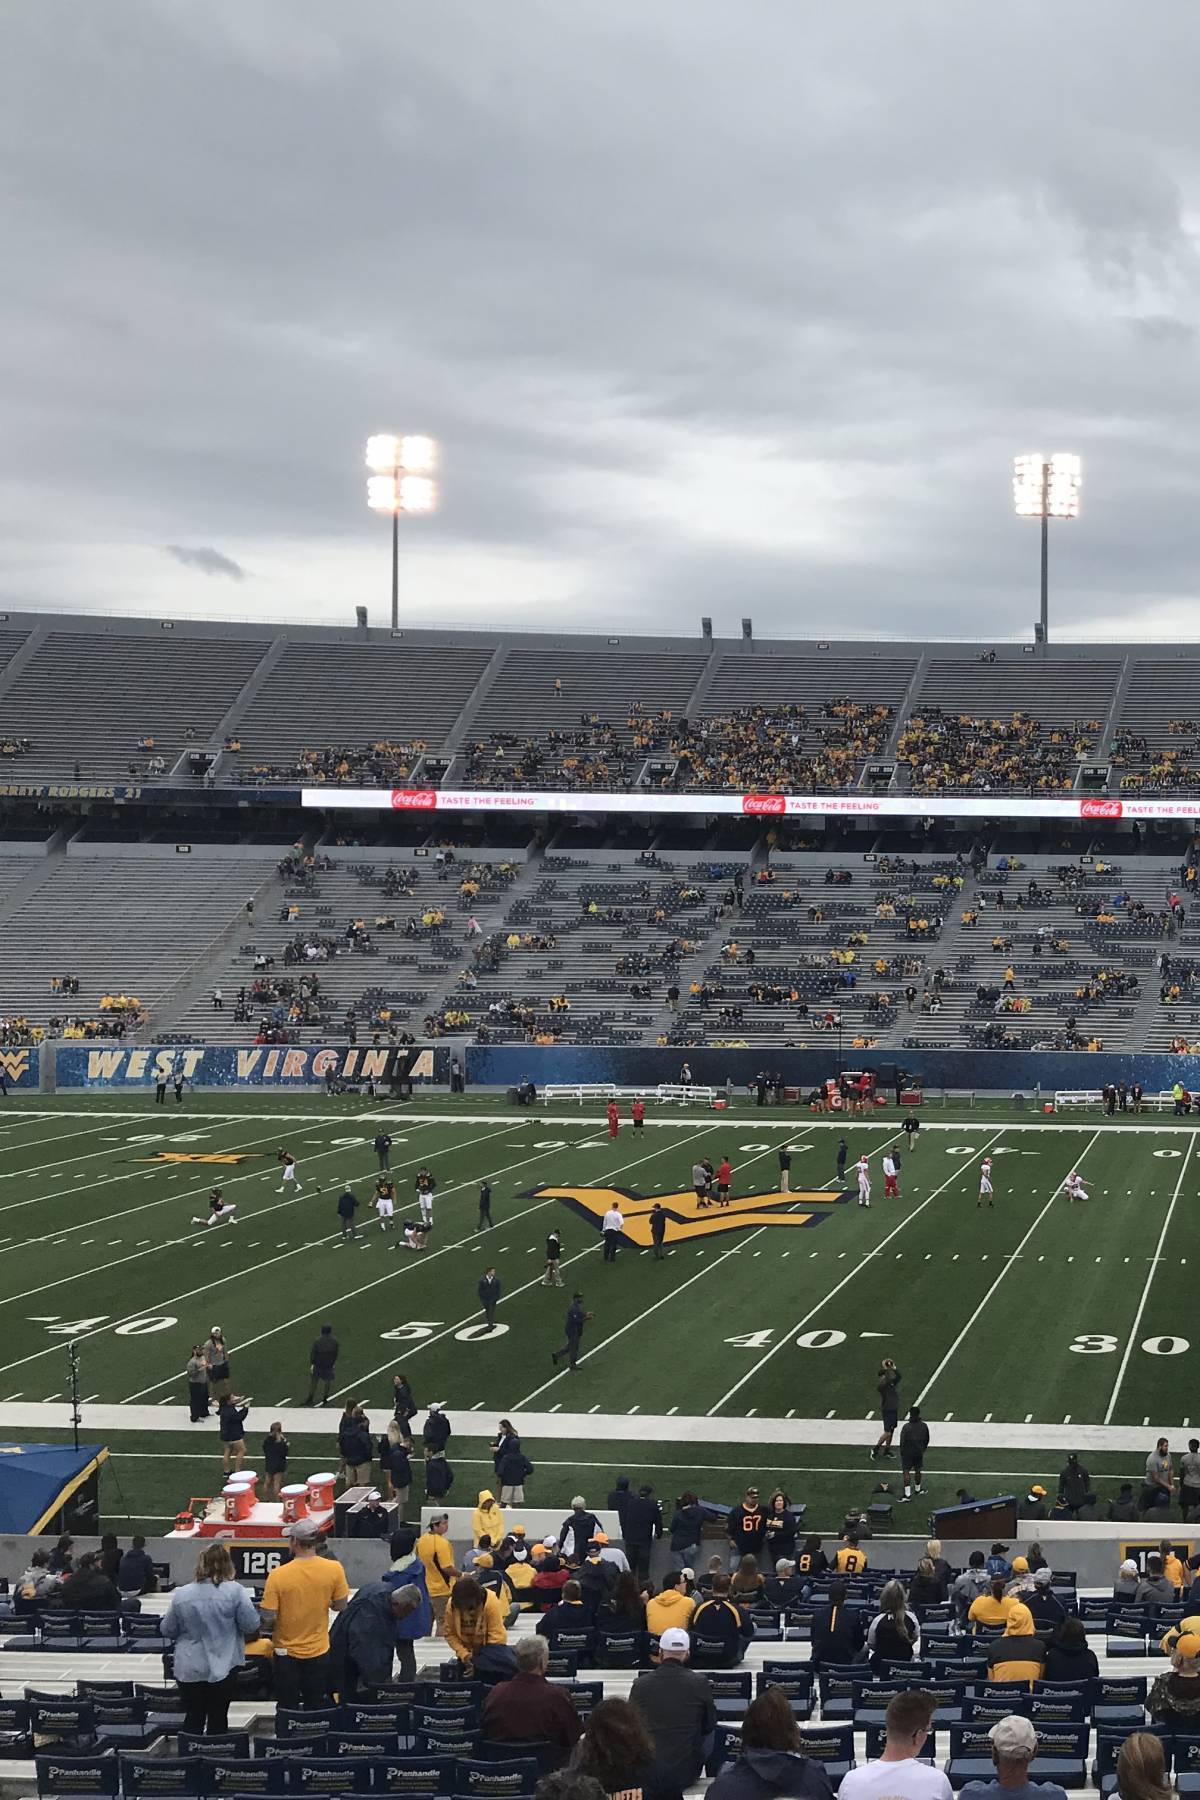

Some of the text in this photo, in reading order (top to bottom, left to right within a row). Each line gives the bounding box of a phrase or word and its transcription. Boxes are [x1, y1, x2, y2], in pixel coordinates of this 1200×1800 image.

[47, 786, 116, 799] RODGERS
[123, 787, 142, 799] 21
[441, 796, 535, 806] TASTE THE FEELING
[789, 801, 880, 811] TASTE THE FEELING
[1126, 805, 1153, 814] TASTE
[1156, 806, 1175, 814] THE
[87, 1050, 204, 1079] WEST
[311, 1488, 320, 1499] G
[226, 1498, 235, 1509] G
[284, 1499, 295, 1510] G
[742, 1515, 762, 1532] 67
[242, 1552, 281, 1575] 126
[800, 1554, 811, 1572] 8
[846, 1555, 858, 1573] 8
[1039, 1703, 1073, 1711] Panhandle
[362, 1713, 397, 1721] Panhandle
[429, 1717, 466, 1726] Panhandle
[802, 1736, 842, 1746] Panhandle
[1040, 1733, 1079, 1742] Panhandle
[434, 1740, 474, 1751] Panhandle
[56, 1768, 102, 1778] Panhandle
[223, 1768, 269, 1779] Panhandle
[310, 1768, 356, 1779] Panhandle
[395, 1768, 441, 1778] Panhandle
[477, 1772, 524, 1784] Panhandle
